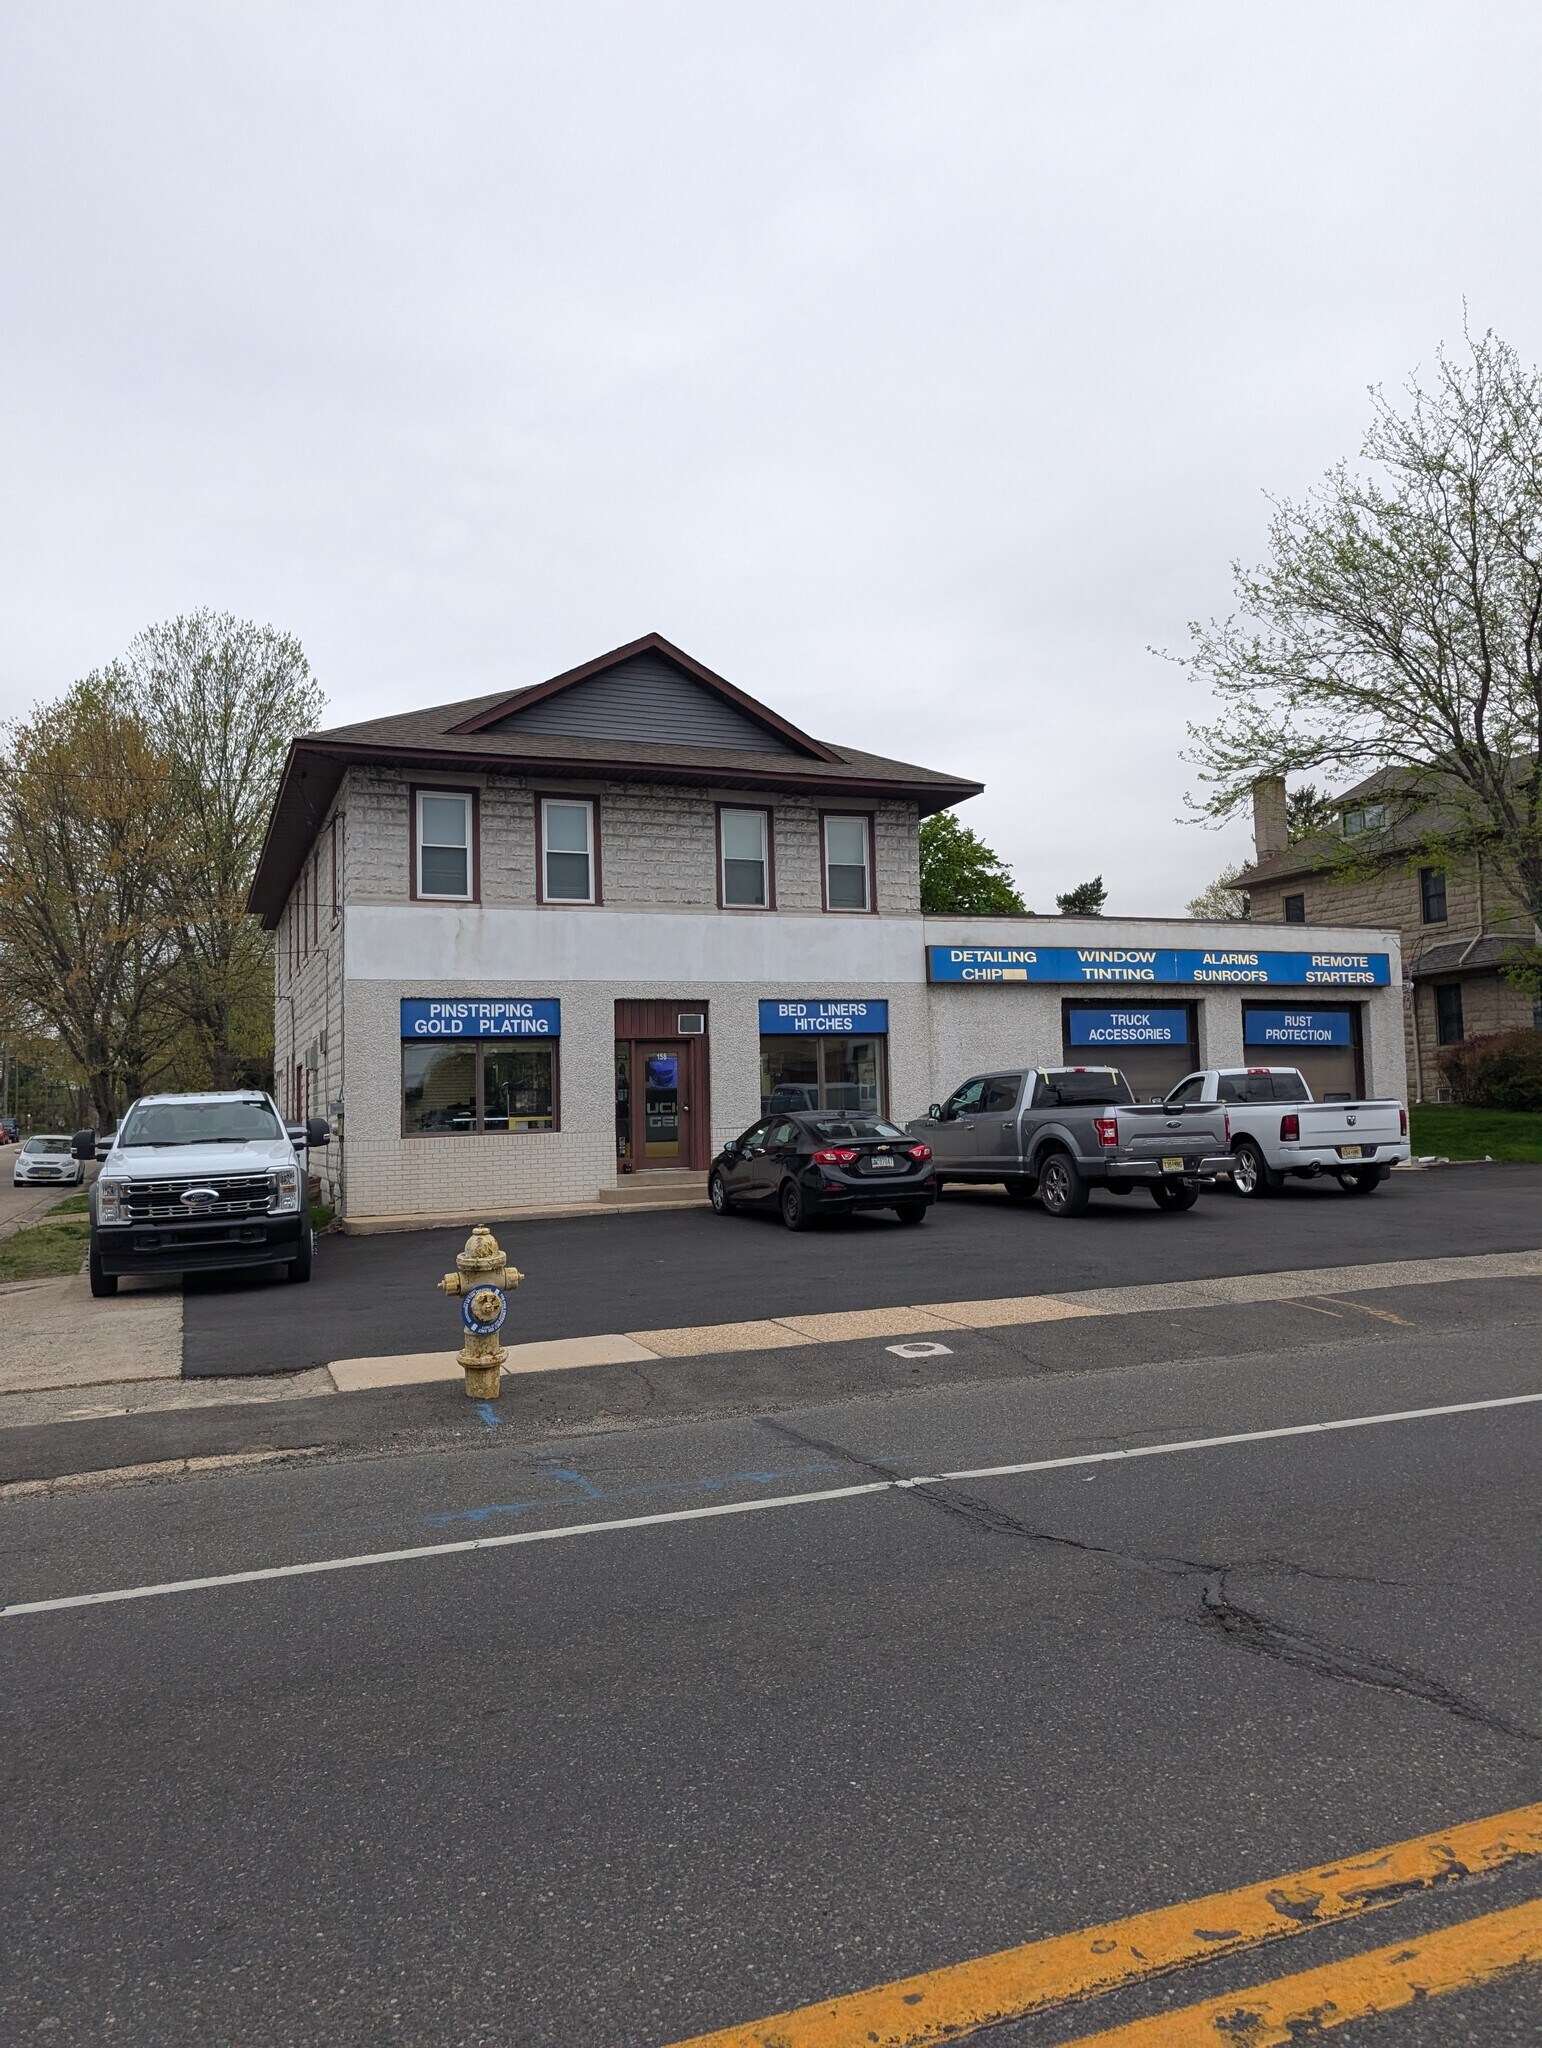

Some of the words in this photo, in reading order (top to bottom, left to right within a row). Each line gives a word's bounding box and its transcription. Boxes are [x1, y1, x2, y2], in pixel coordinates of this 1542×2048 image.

[950, 950, 1037, 963] DETAILING
[1077, 950, 1156, 963] WINDOW
[1202, 953, 1259, 966] ALARMS
[1311, 955, 1369, 968] REMOTE
[961, 968, 1003, 980] CHIP
[1081, 967, 1155, 980] TINTING
[1193, 969, 1268, 982] SUNROOFS
[1305, 971, 1375, 983] STARTERS
[429, 1003, 534, 1018] PINSTRIPING
[778, 1004, 807, 1017] BED
[819, 1003, 867, 1016] LINERS
[414, 1019, 463, 1034] GOLD
[479, 1019, 549, 1033] PLATING
[794, 1018, 853, 1031] HITCHES
[1110, 1014, 1150, 1026] TRUCK
[1284, 1015, 1312, 1027] RUST
[1088, 1028, 1171, 1041] ACCESSORIES
[1265, 1029, 1332, 1041] PROTECTION
[656, 1052, 668, 1061] 158
